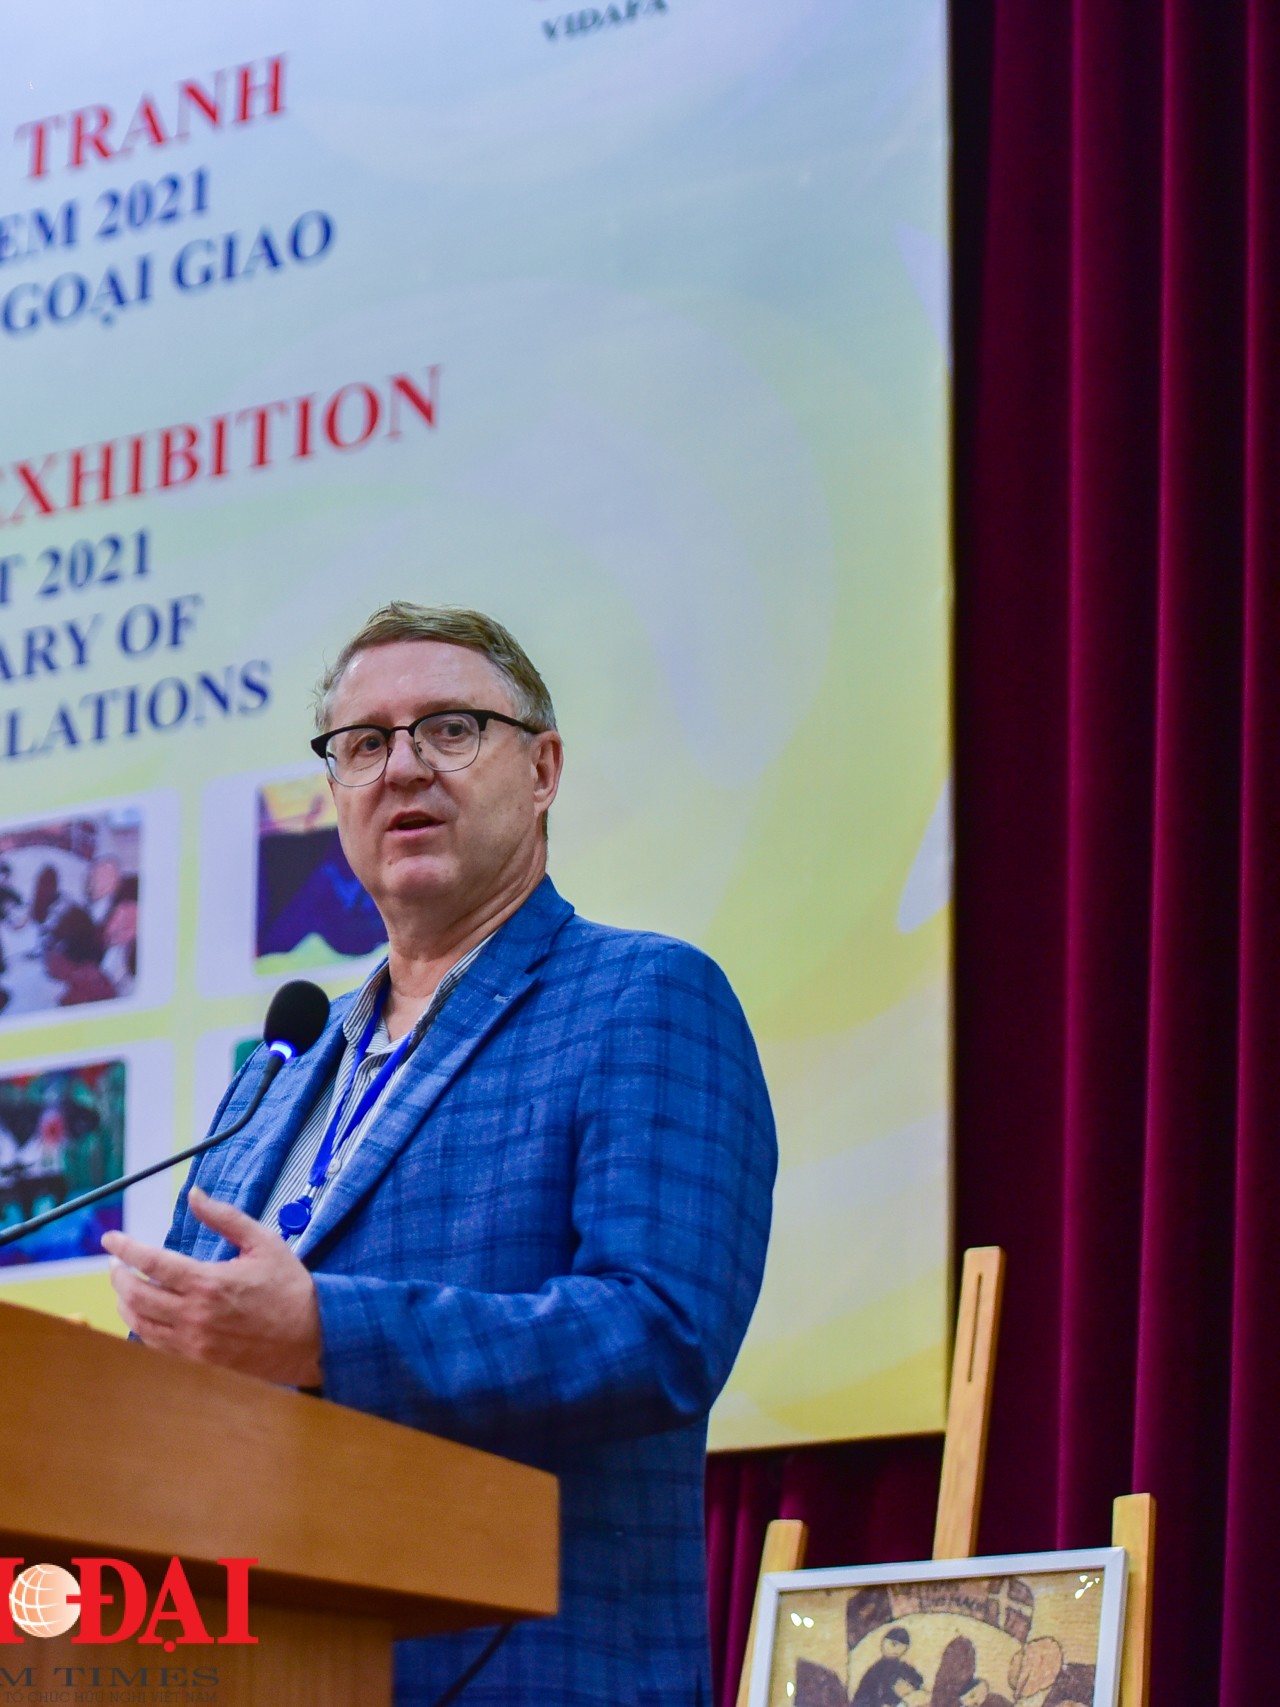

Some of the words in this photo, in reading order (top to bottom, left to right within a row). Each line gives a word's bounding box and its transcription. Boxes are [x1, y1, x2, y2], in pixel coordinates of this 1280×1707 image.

[13, 52, 288, 181] TRANH
[96, 165, 211, 241] 2021
[170, 210, 338, 295] GIAO
[37, 529, 153, 599] 2021
[119, 592, 203, 658] OF
